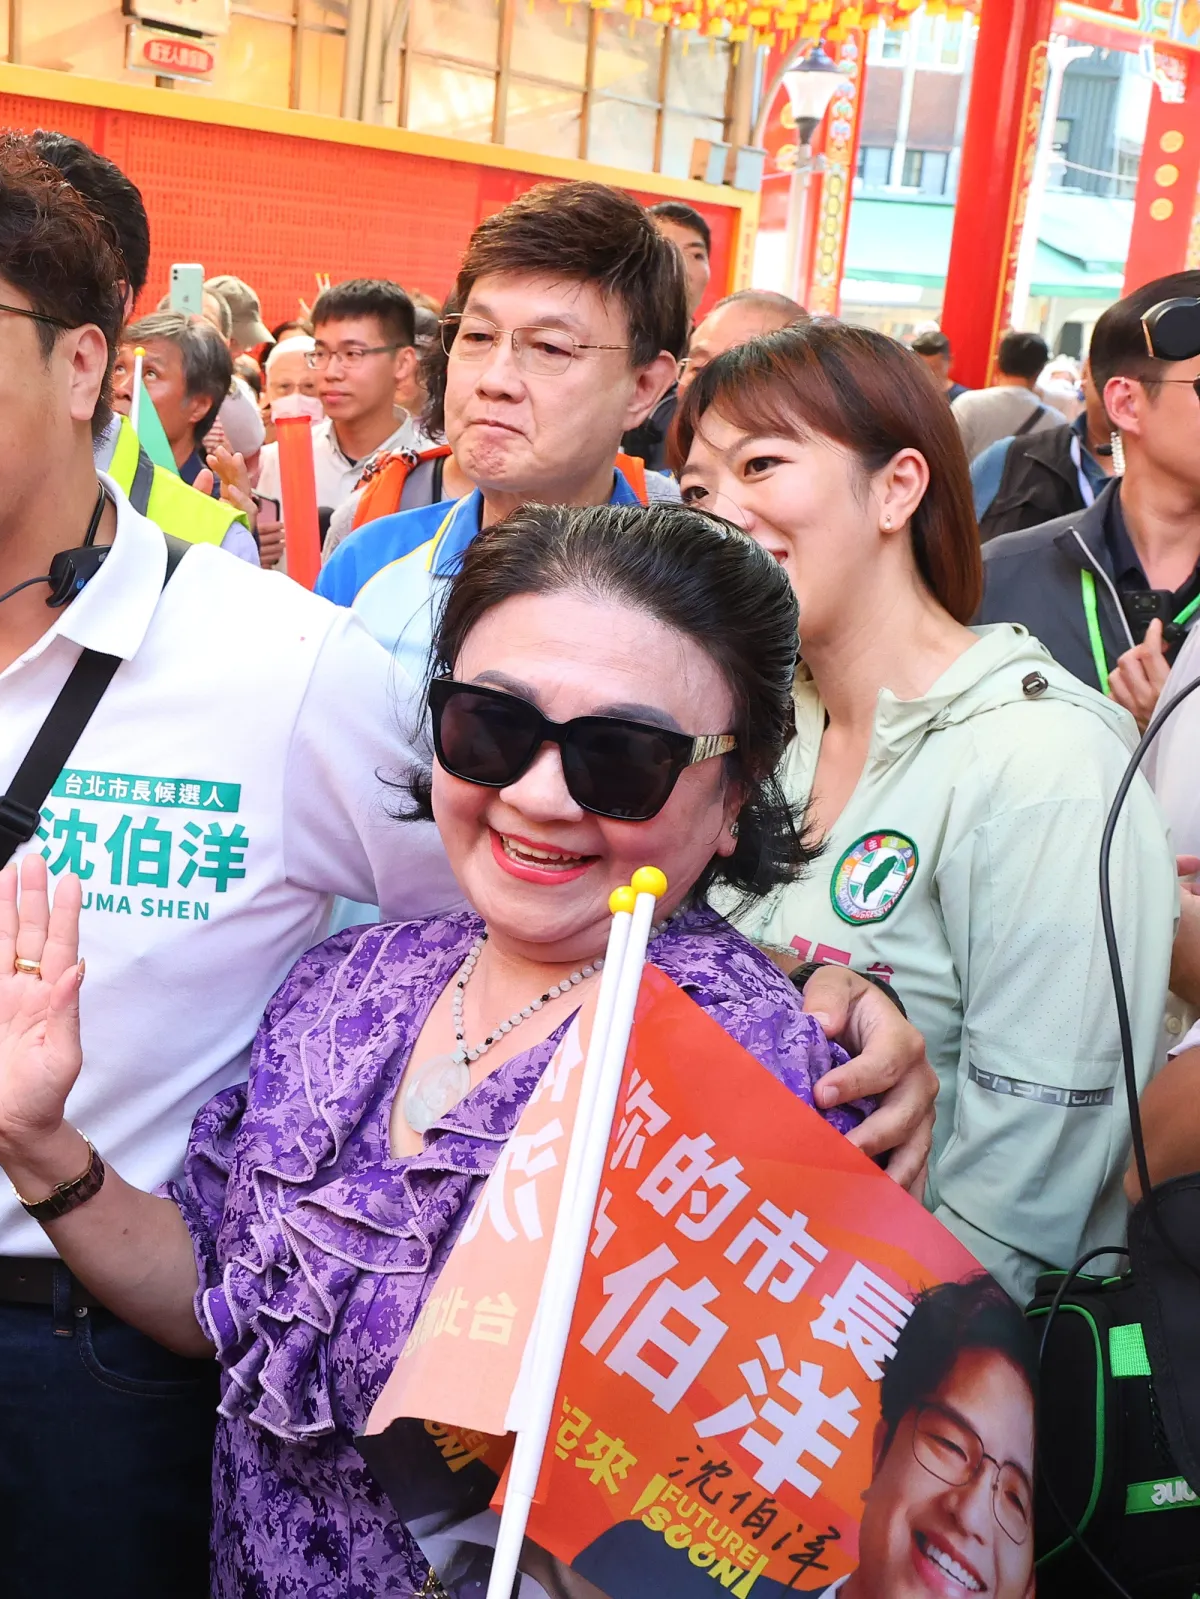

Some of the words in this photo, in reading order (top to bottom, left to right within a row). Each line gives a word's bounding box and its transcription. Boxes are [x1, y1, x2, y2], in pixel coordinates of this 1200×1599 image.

[64, 773, 225, 808] 台北市長候選人
[35, 808, 250, 893] 沈伯洋
[81, 891, 132, 915] UMA
[140, 898, 210, 921] SHEN
[580, 1187, 862, 1500] 伯洋
[641, 1505, 745, 1589] SOON
[660, 1482, 758, 1567] FUTURE
